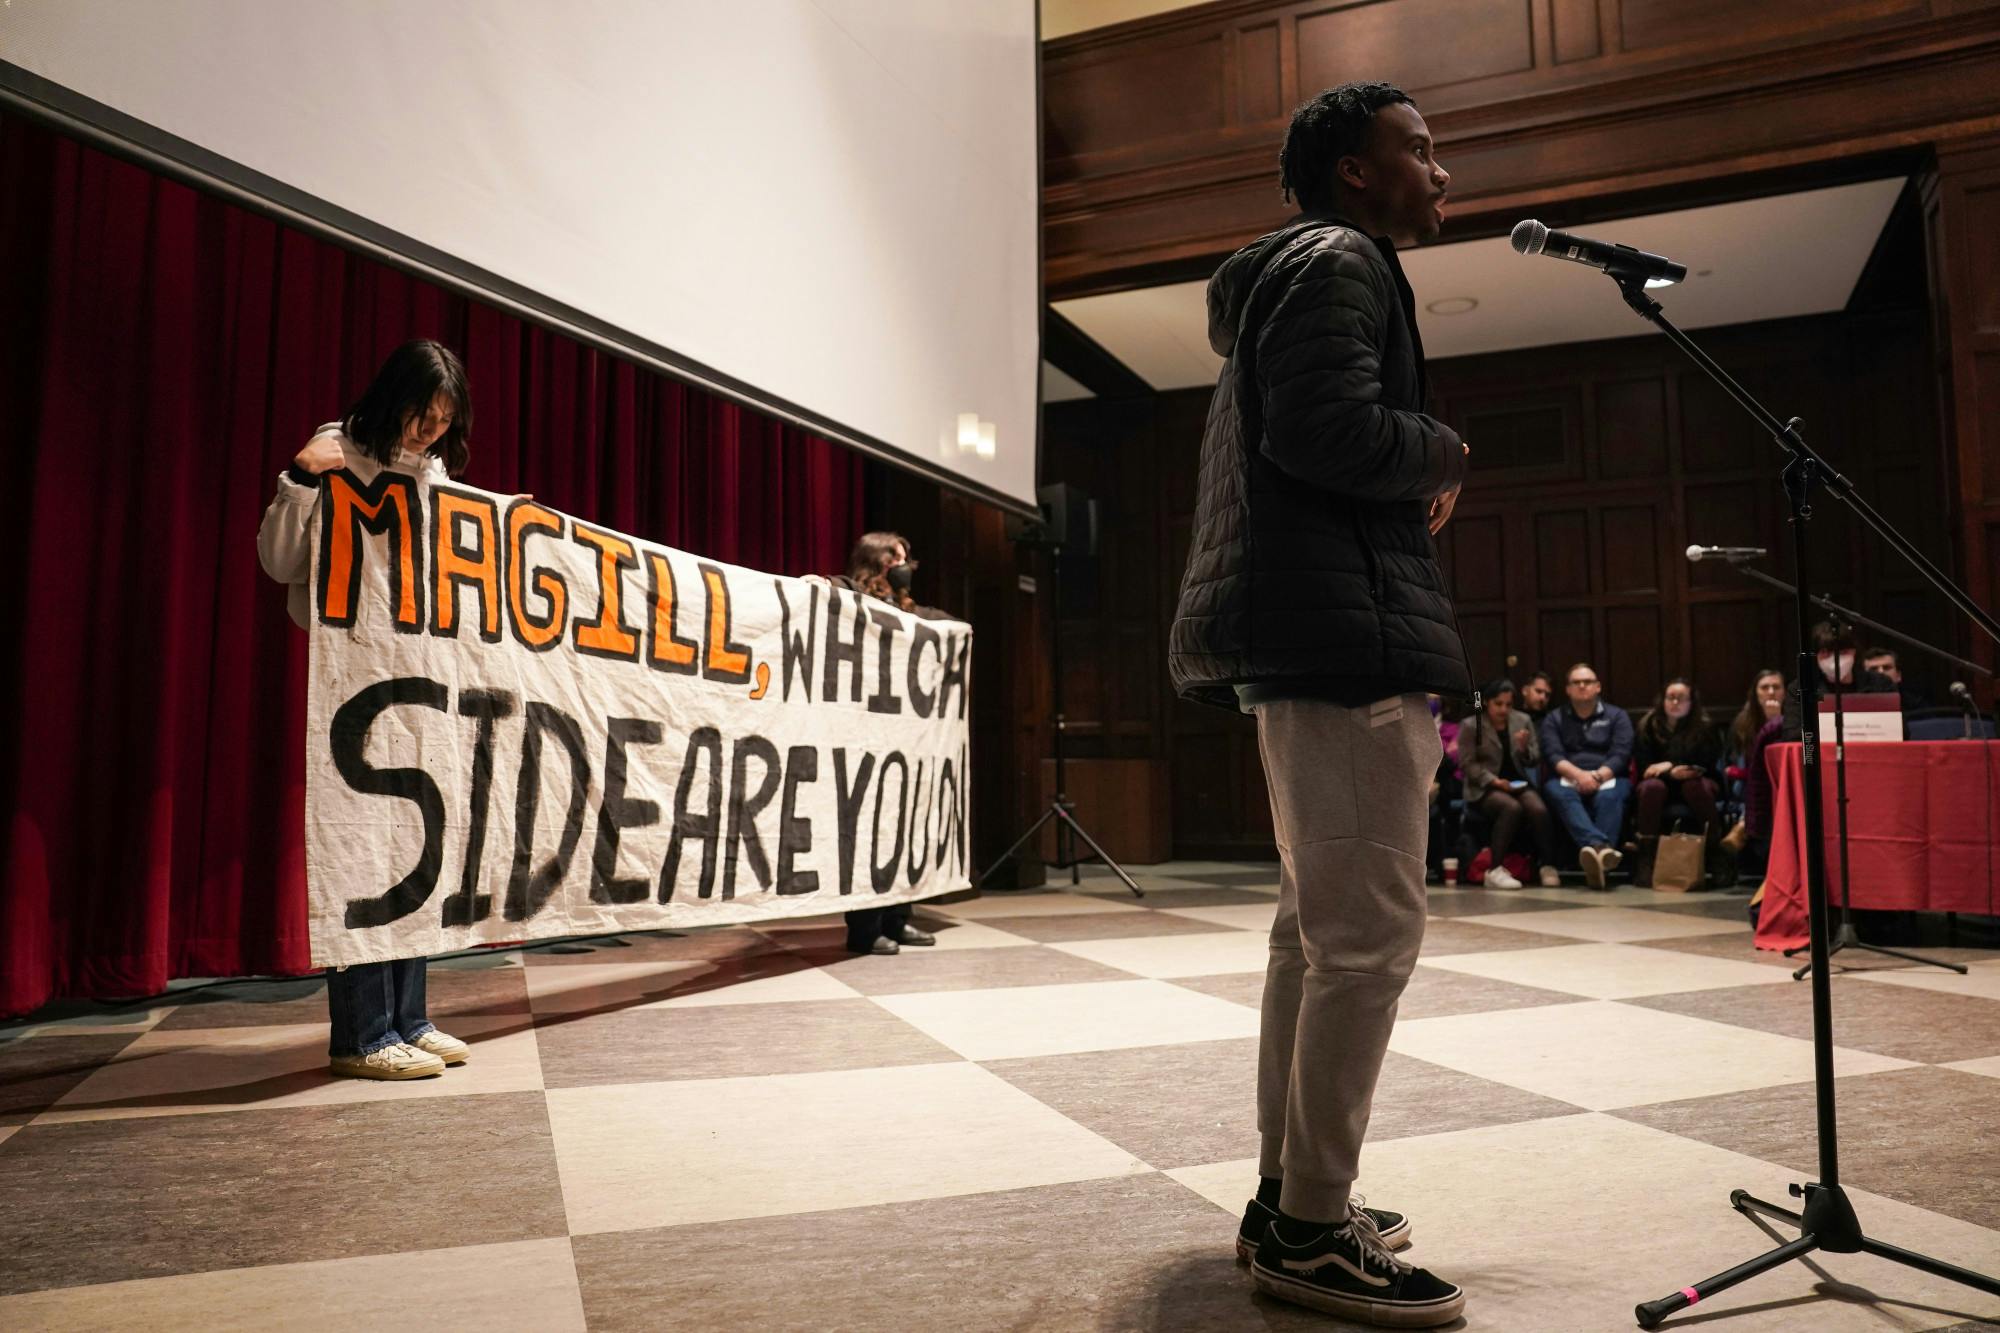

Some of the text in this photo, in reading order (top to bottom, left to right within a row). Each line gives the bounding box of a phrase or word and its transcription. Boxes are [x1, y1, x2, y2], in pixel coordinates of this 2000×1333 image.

[318, 468, 970, 721] MAGILL, WHICH
[329, 676, 967, 930] SIDE ARE YOU ON
